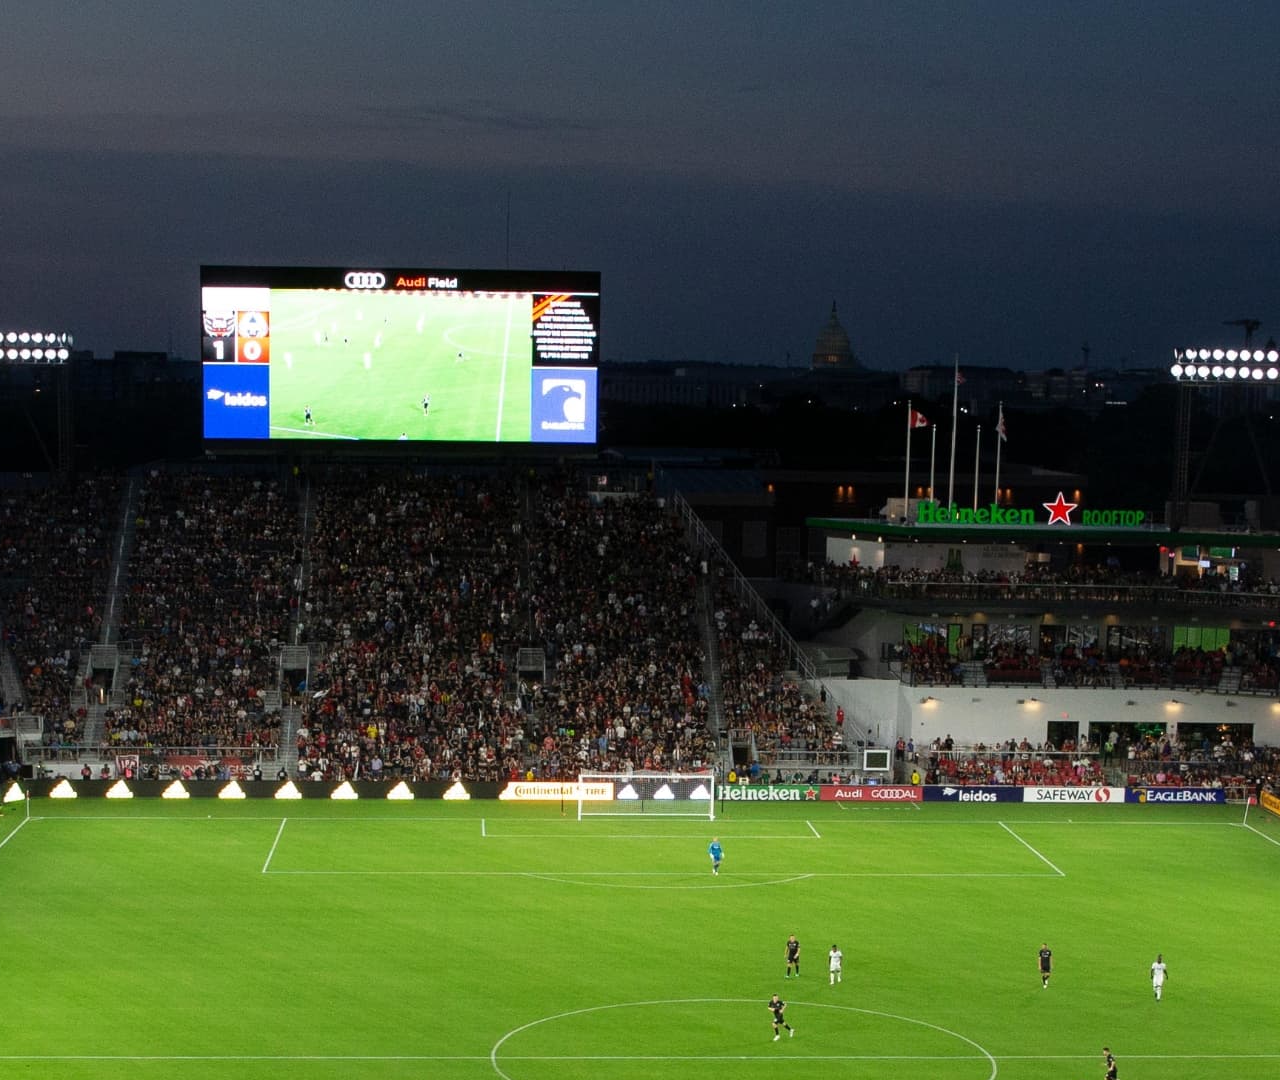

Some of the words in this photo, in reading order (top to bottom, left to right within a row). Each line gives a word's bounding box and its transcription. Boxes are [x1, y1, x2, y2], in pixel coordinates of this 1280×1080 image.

[396, 277, 426, 287] Audi
[427, 277, 458, 288] Field
[213, 340, 224, 360] 1
[243, 341, 262, 360] 0
[917, 501, 1035, 524] Heineken
[1082, 509, 1145, 527] ROOFTOP
[718, 786, 800, 800] Heineken
[834, 789, 863, 798] Audi
[959, 790, 997, 801] leidos
[1036, 789, 1093, 801] SAFEWAY
